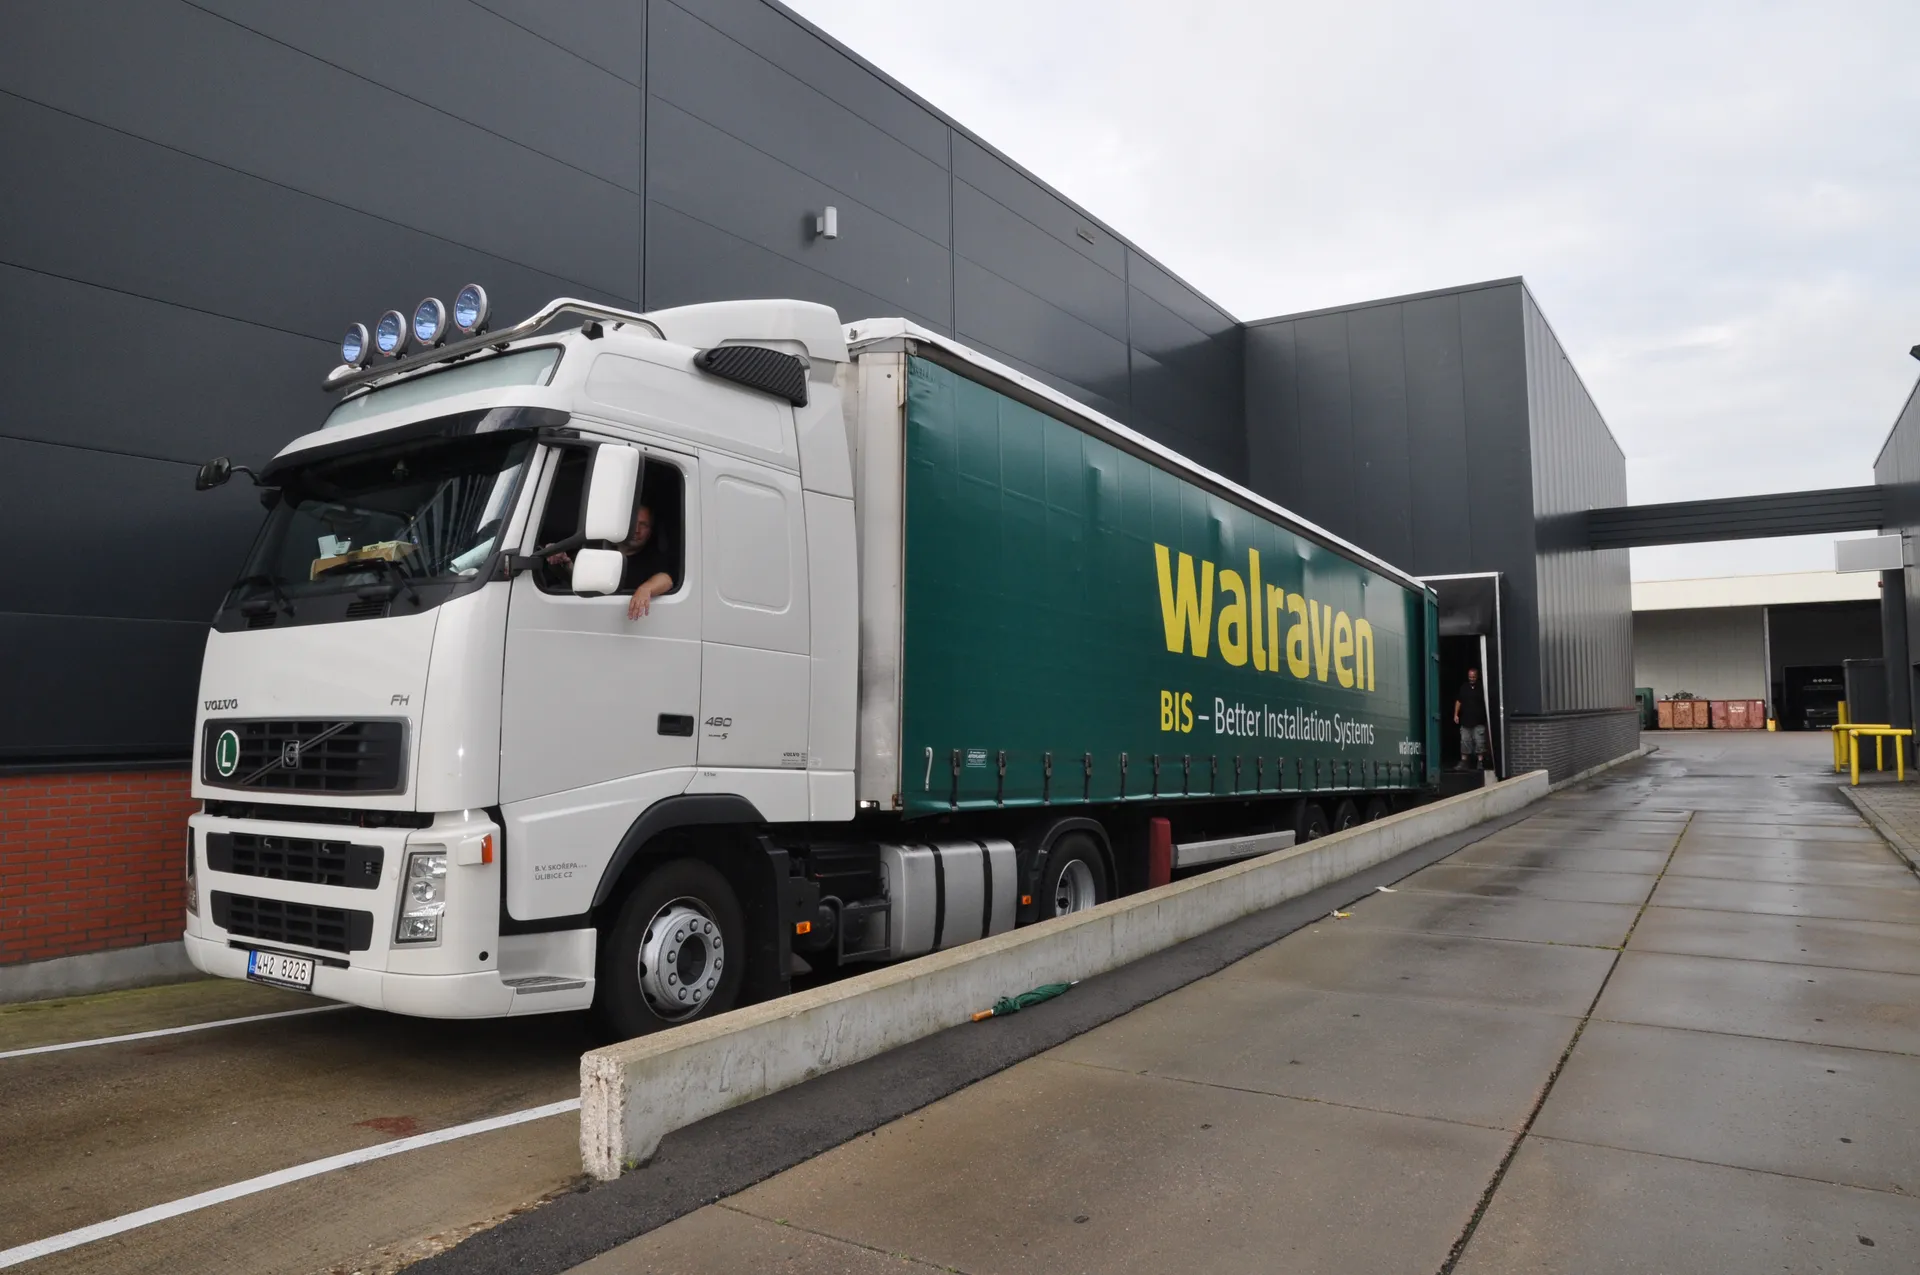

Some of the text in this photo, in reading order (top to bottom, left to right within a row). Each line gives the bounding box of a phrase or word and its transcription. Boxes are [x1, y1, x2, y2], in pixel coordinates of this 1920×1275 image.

[1153, 542, 1376, 692] walraven
[204, 698, 239, 711] VOLVO
[390, 693, 411, 706] FH
[704, 716, 733, 727] 480
[1160, 689, 1194, 734] BIS
[1214, 697, 1261, 738] Better
[1264, 703, 1332, 743] Installation
[1334, 712, 1375, 752] Systems
[221, 739, 232, 767] L
[257, 954, 307, 981] 4H2 8226
